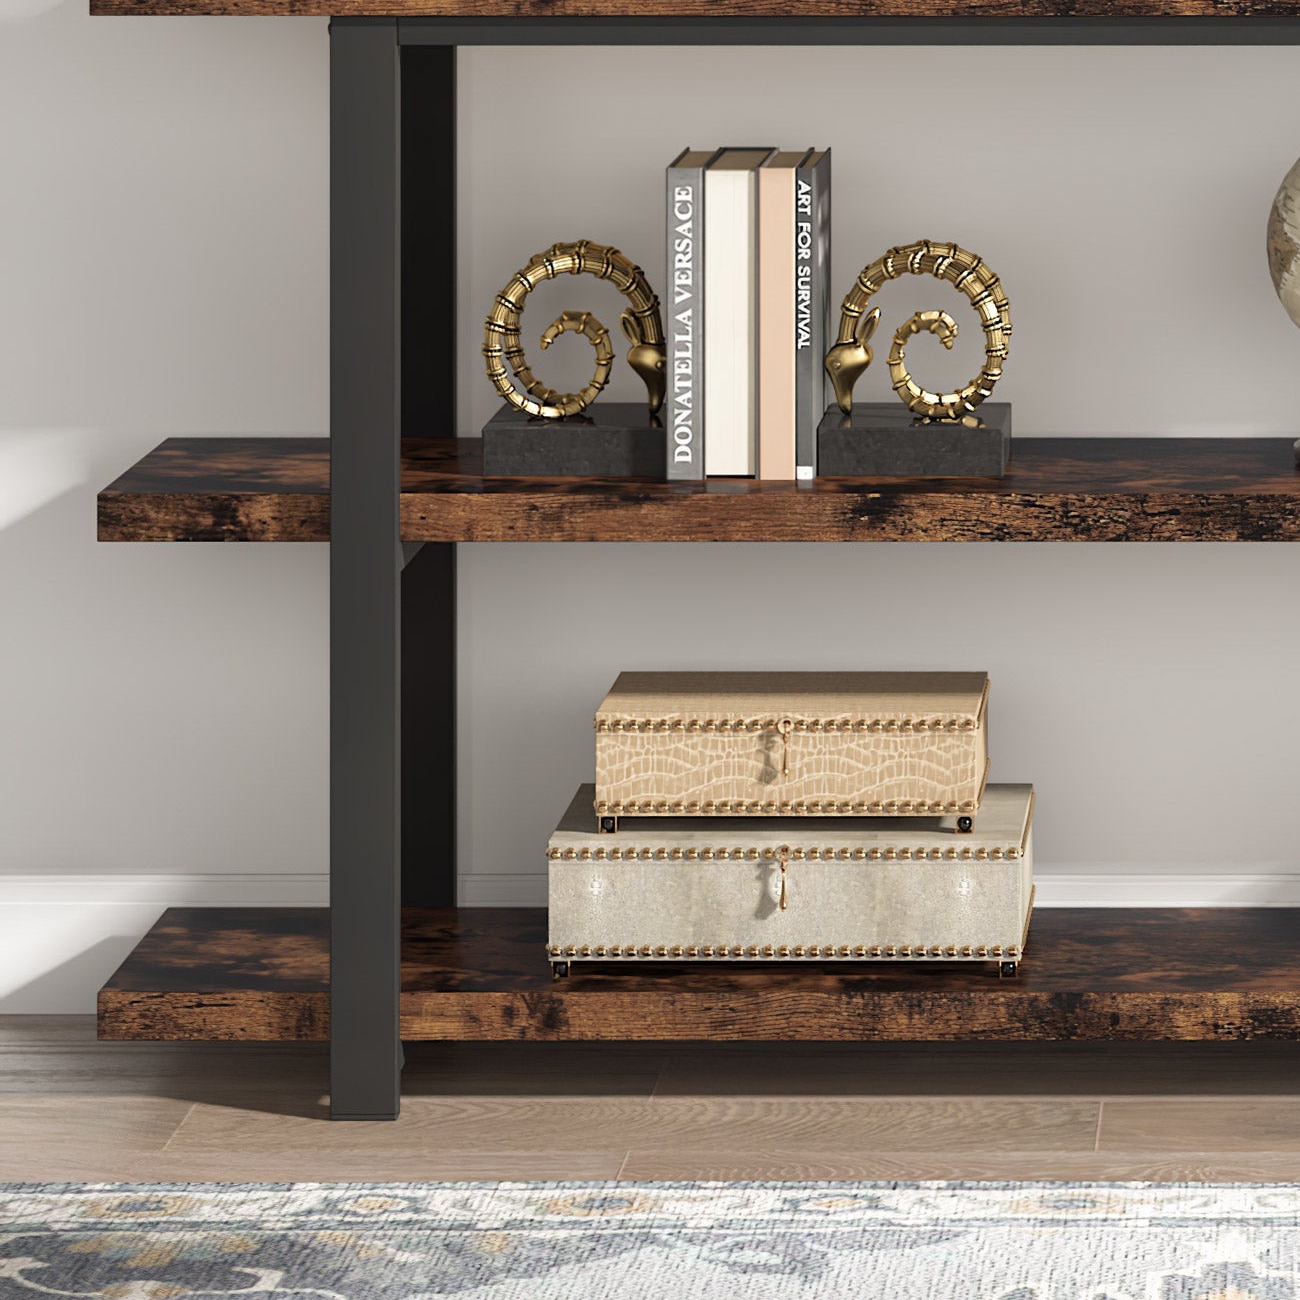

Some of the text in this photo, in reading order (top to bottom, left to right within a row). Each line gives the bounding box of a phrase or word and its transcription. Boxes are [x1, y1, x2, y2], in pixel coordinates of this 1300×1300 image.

[674, 186, 693, 463] DONATELLA VERSACE
[797, 180, 812, 350] ART FOR SURVIVAL
